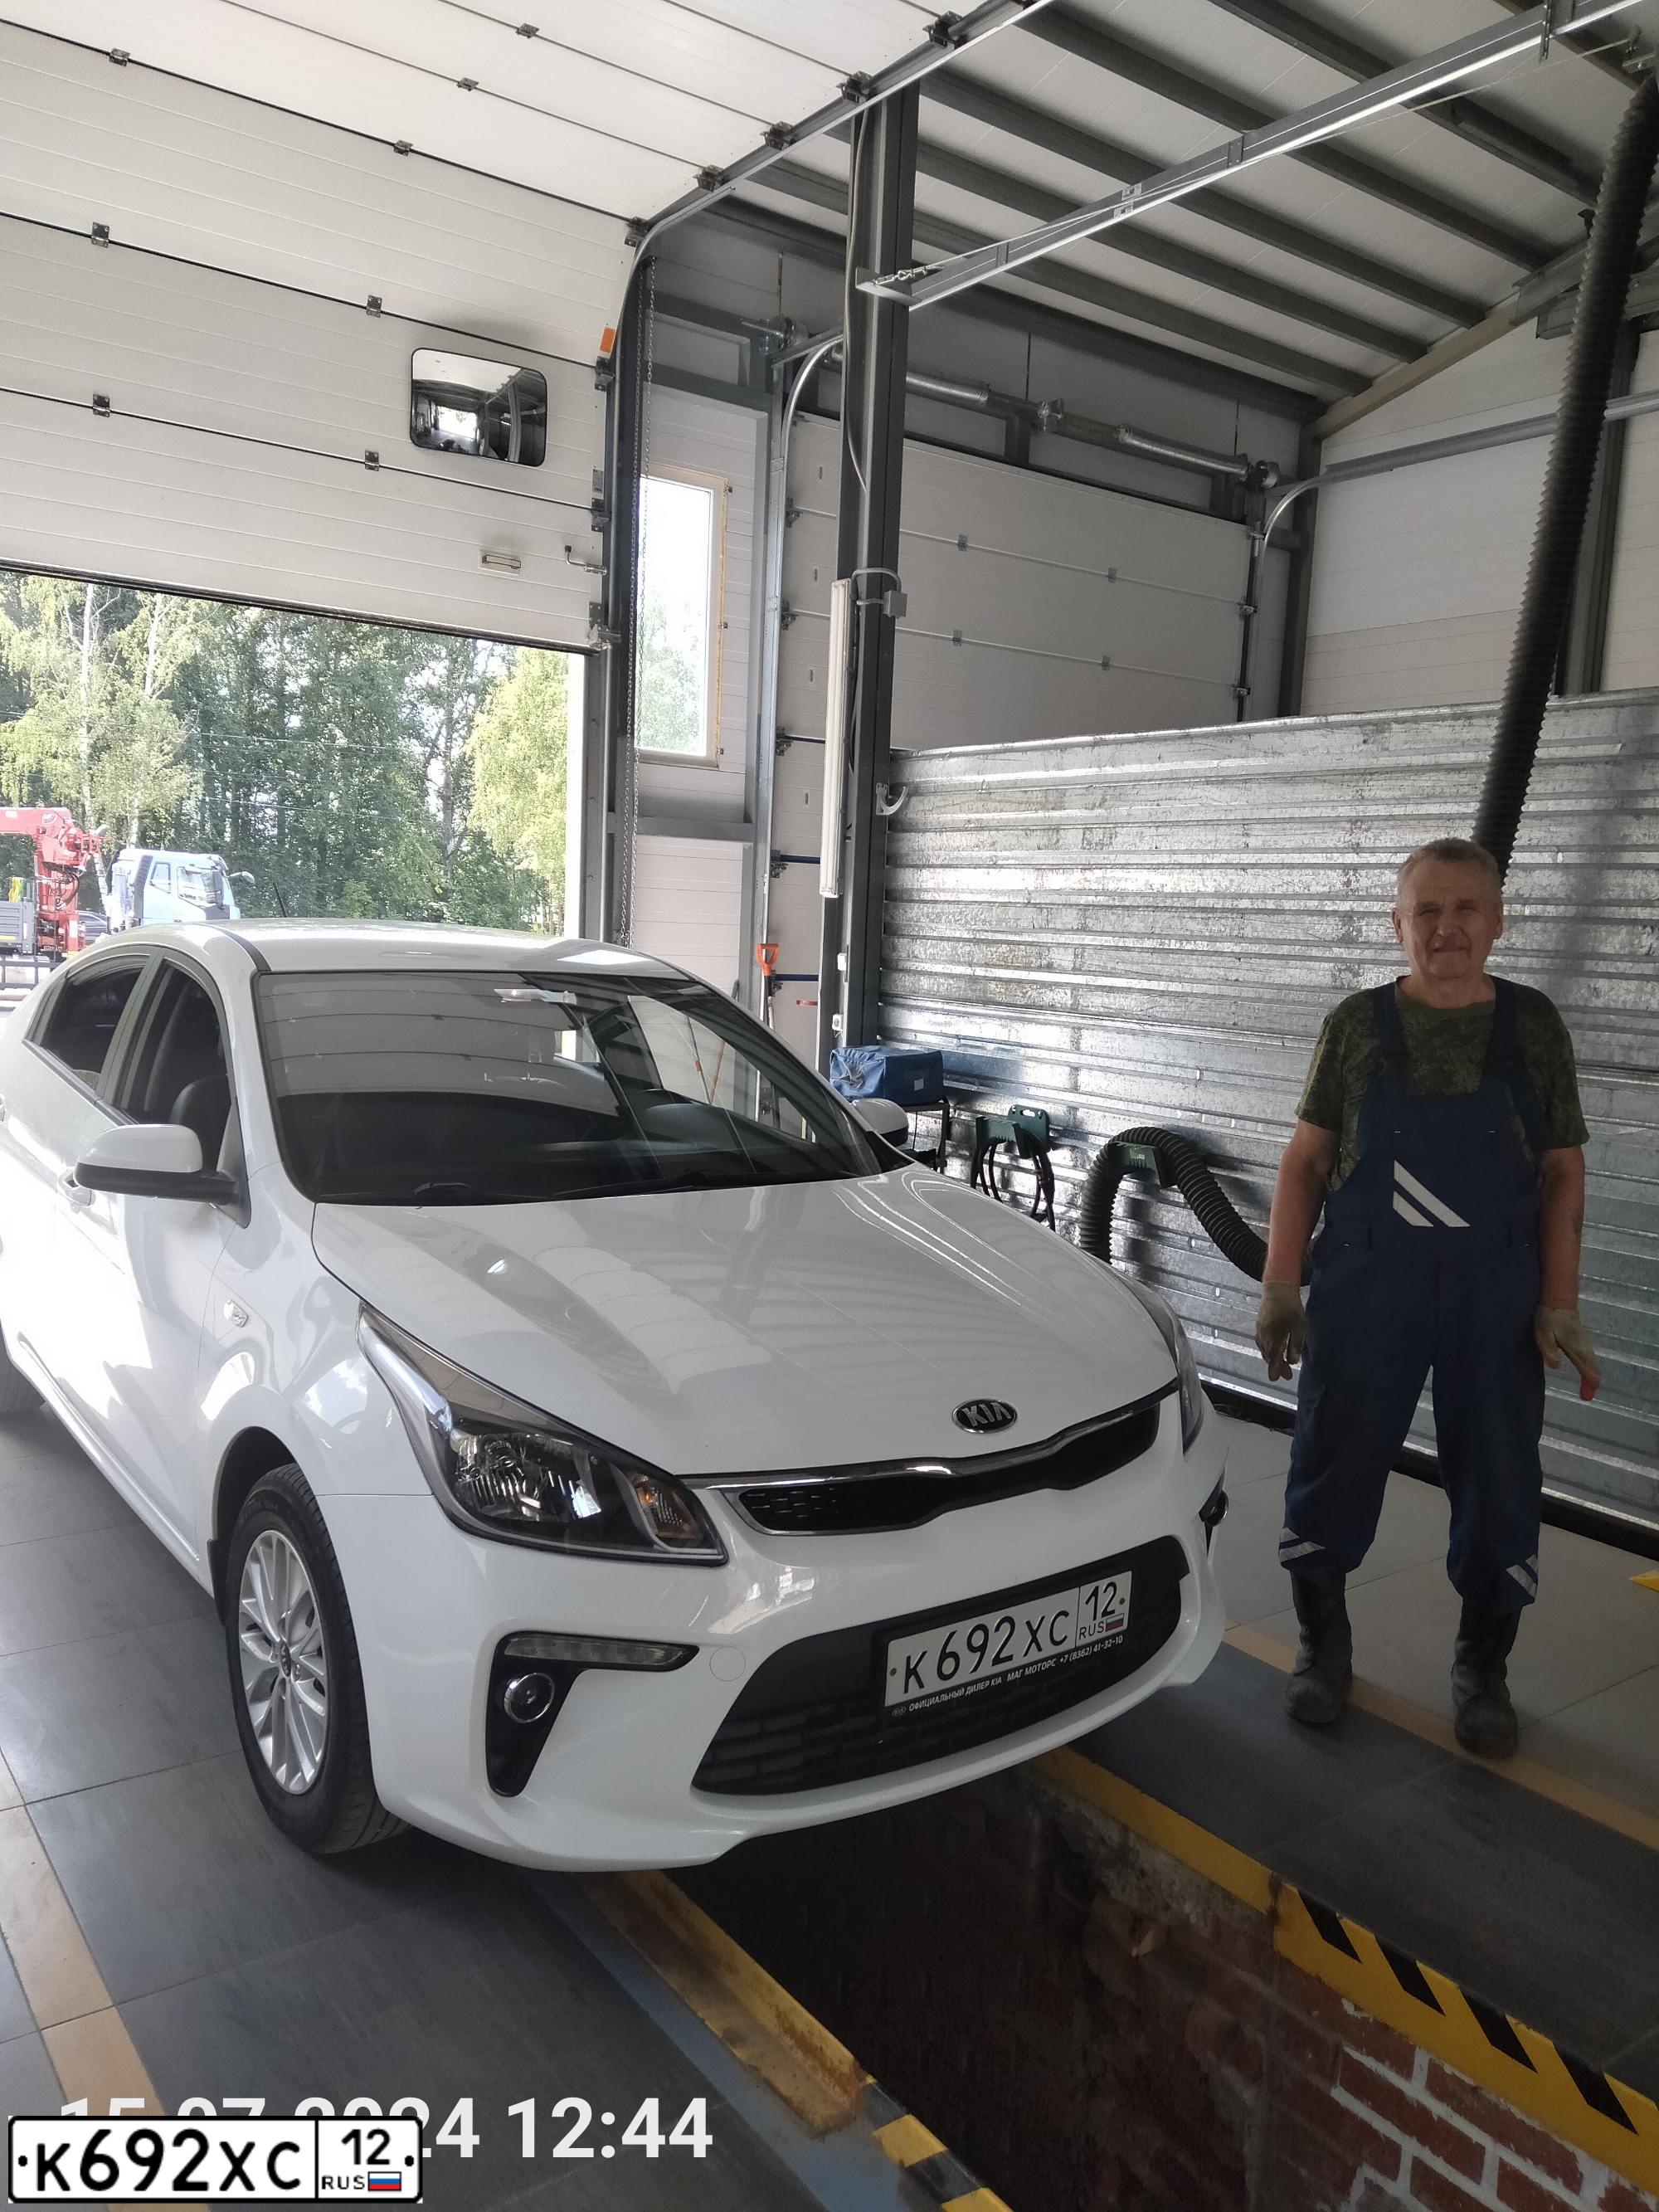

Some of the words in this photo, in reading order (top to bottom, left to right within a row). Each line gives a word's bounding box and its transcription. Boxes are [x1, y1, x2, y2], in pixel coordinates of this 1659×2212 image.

[961, 1401, 1011, 1427] KIA
[903, 1610, 1070, 1694] К692ХС
[1085, 1581, 1118, 1621] 12
[1079, 1620, 1105, 1640] RUS
[908, 1686, 965, 1712] ОФИЦИАЛЬНЫЙ
[965, 1680, 990, 1696] ДИЛЕР
[990, 1676, 1002, 1687] KIA
[1007, 1669, 1024, 1683] МАГ
[1024, 1658, 1058, 1676] МОТОРС
[1059, 1654, 1069, 1664] +7
[1092, 1635, 1123, 1653] 41-32-10
